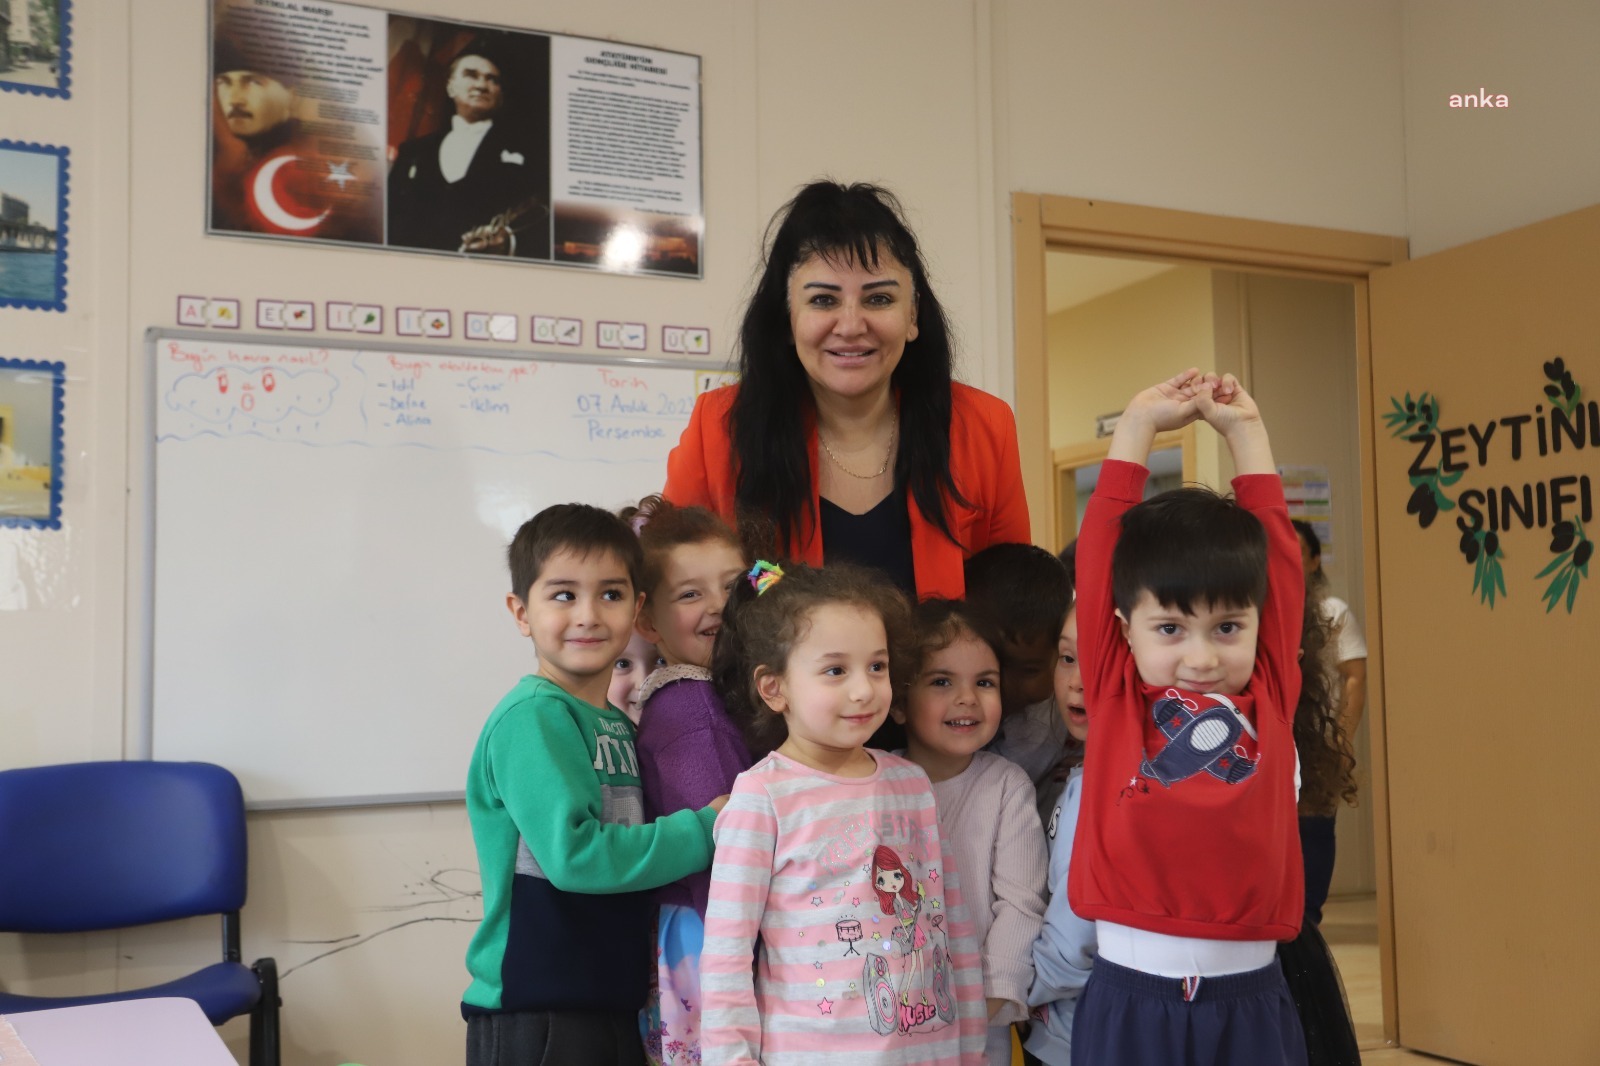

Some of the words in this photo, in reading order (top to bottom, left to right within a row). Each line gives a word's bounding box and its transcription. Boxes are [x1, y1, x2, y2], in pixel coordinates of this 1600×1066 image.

[185, 304, 197, 318] A
[265, 307, 275, 321] E
[471, 318, 483, 333] O
[603, 328, 614, 342] U
[596, 367, 649, 391] Tarih
[1457, 474, 1593, 532] SINIFI
